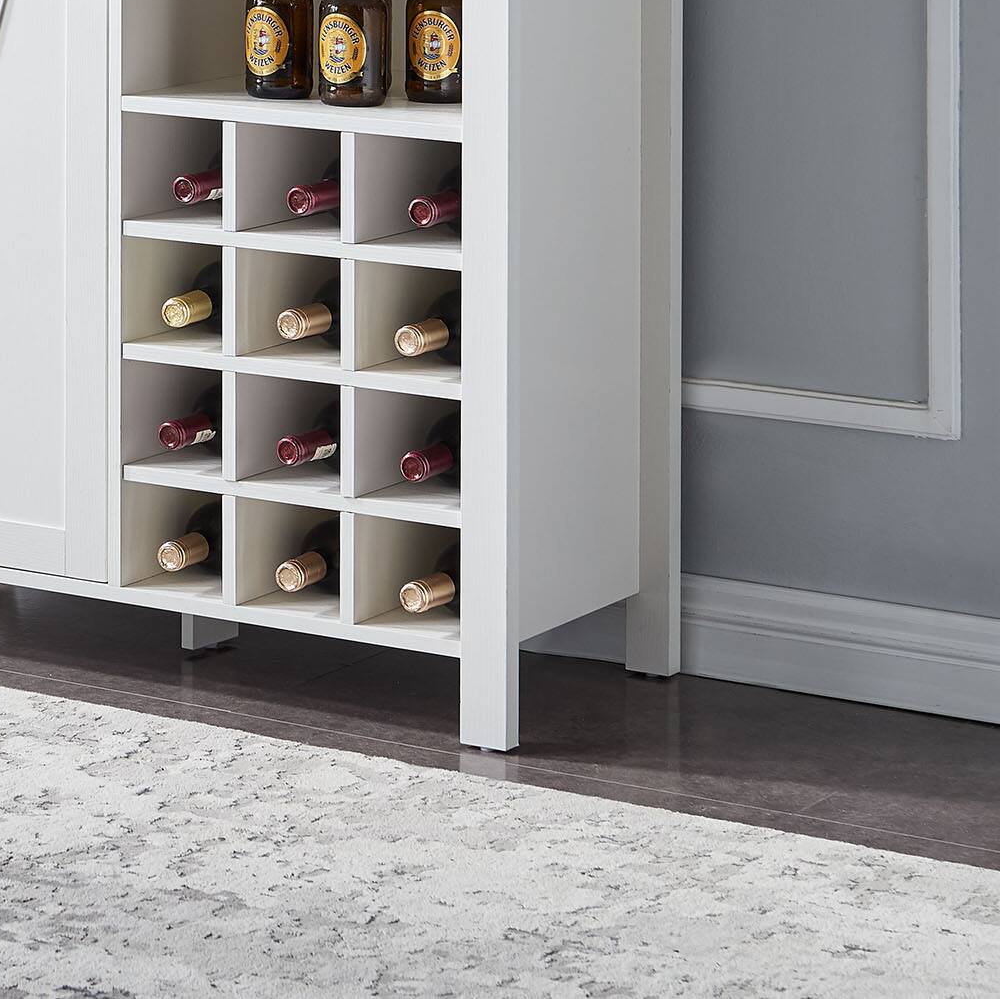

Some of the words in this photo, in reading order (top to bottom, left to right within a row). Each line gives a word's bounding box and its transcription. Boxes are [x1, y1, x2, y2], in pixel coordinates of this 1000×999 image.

[413, 17, 455, 41] FLENSBURGER
[249, 53, 275, 67] WEIZEN
[324, 60, 352, 74] WEIZEN
[417, 57, 447, 71] WEIZEN
